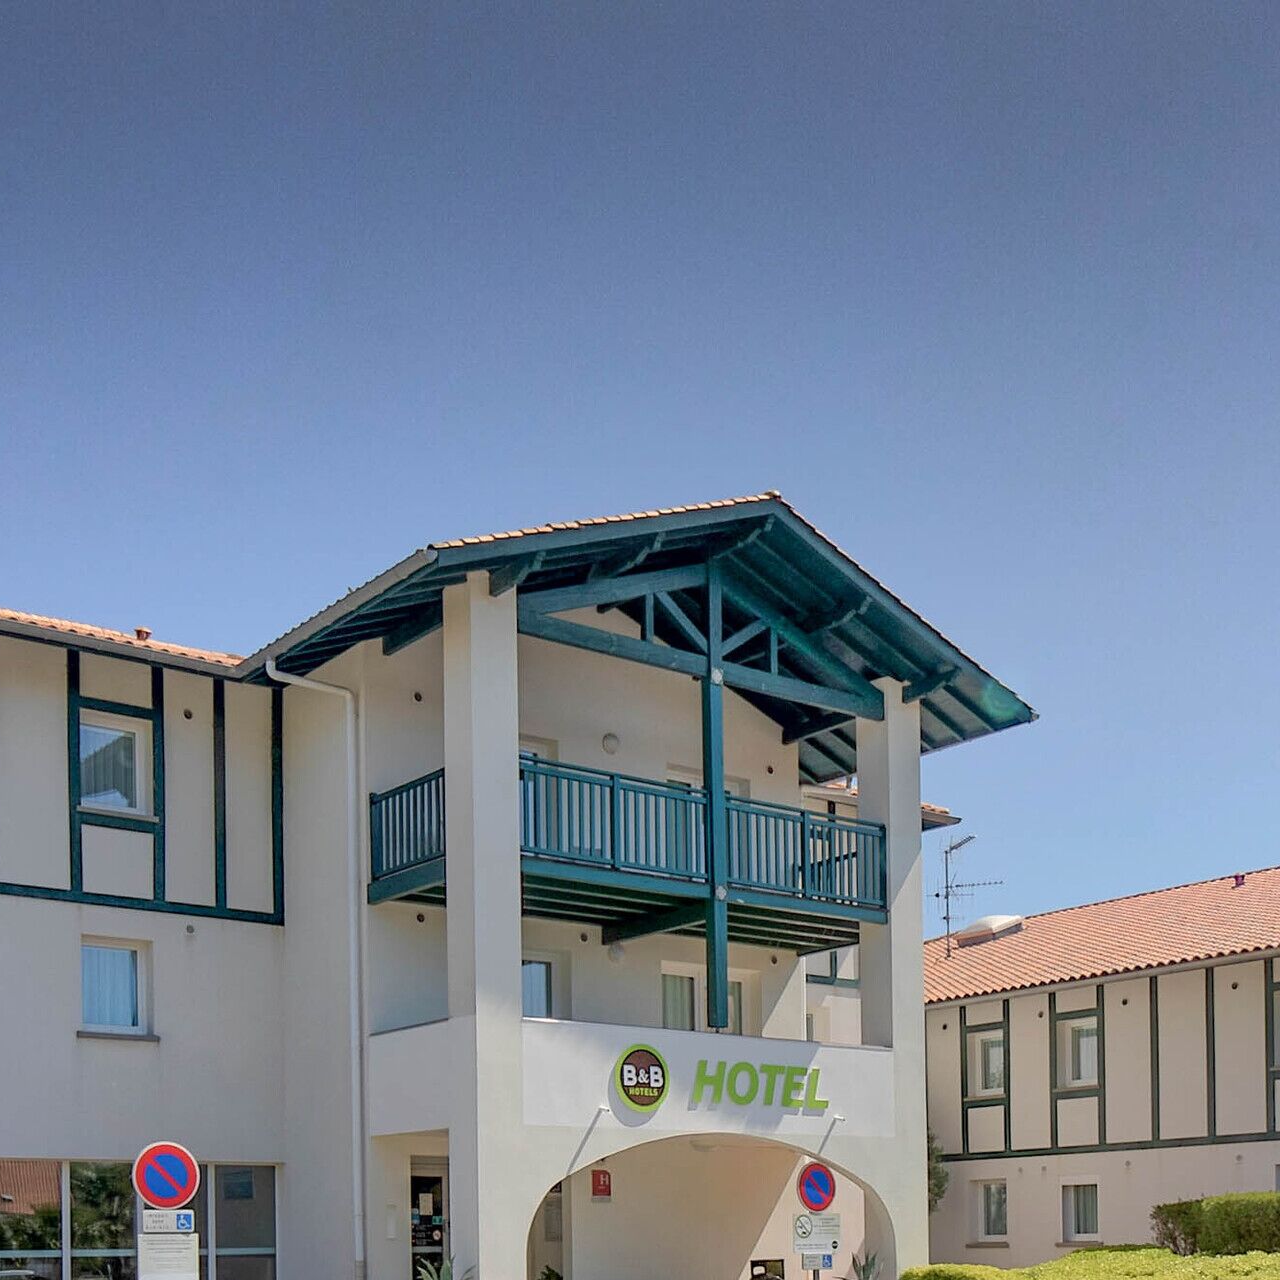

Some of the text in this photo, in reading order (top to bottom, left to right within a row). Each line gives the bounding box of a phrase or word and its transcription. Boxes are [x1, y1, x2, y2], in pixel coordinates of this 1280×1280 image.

[623, 1064, 664, 1088] B&B
[693, 1059, 829, 1109] HOTEL
[629, 1087, 659, 1097] HOTELS
